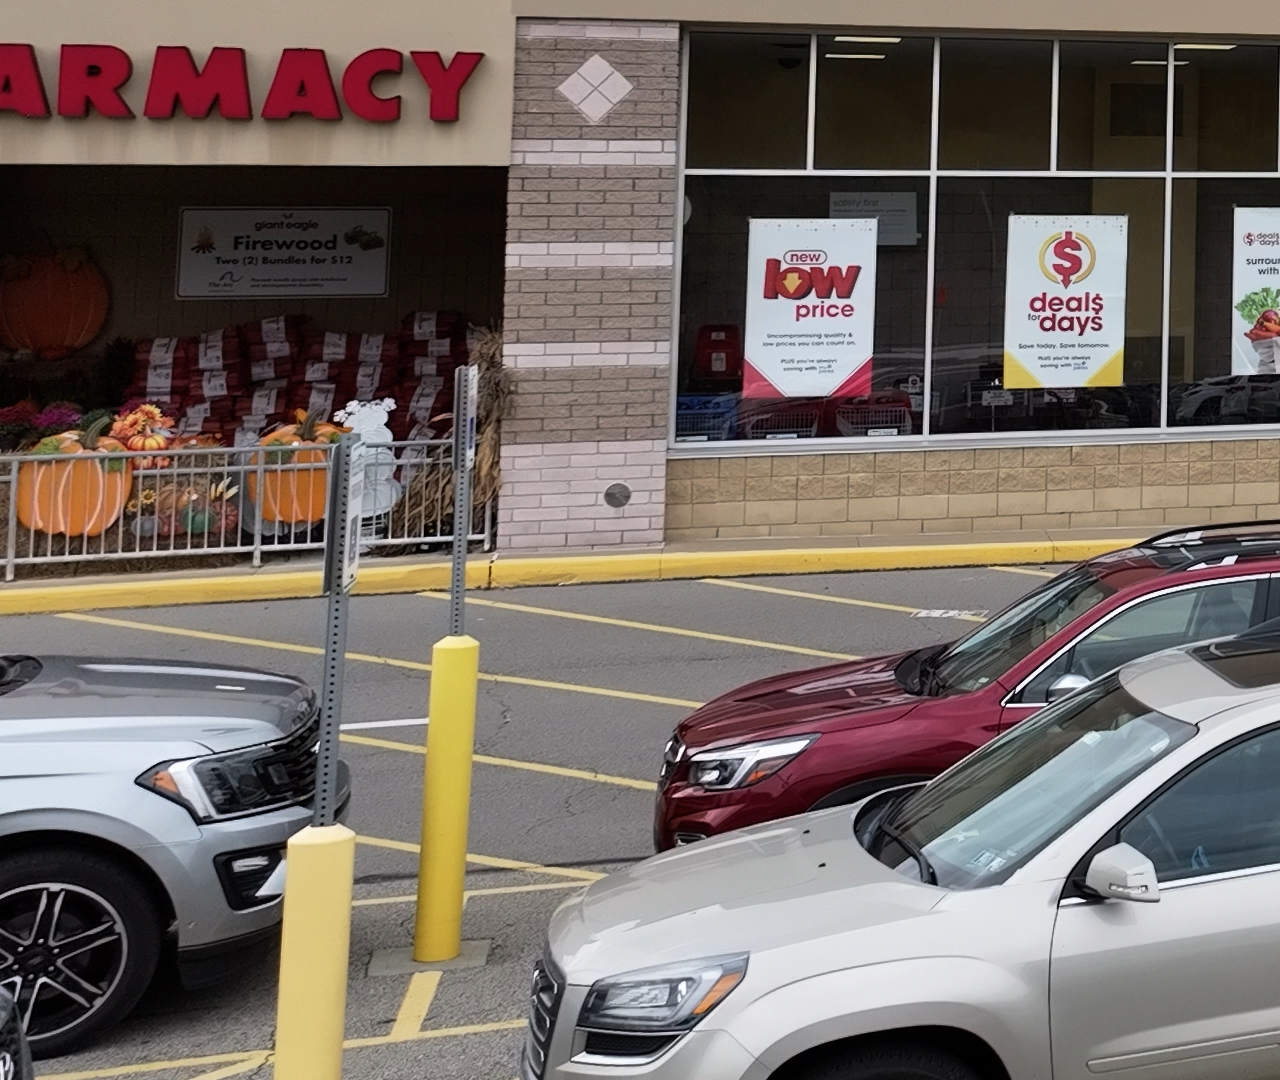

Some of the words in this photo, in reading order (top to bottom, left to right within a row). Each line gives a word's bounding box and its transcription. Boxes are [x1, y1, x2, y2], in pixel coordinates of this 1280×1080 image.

[0, 42, 485, 122] ARMACY
[255, 220, 285, 232] giant
[233, 234, 337, 251] Firewood
[215, 256, 239, 265] Two
[243, 256, 258, 266] (2)
[262, 256, 307, 265] Bundles
[310, 256, 327, 265] for
[331, 256, 353, 265] $12
[790, 253, 821, 262] new
[763, 258, 862, 300] low
[1258, 266, 1279, 275] with
[795, 300, 855, 322] price
[1027, 313, 1041, 321] for
[1039, 313, 1103, 336] days
